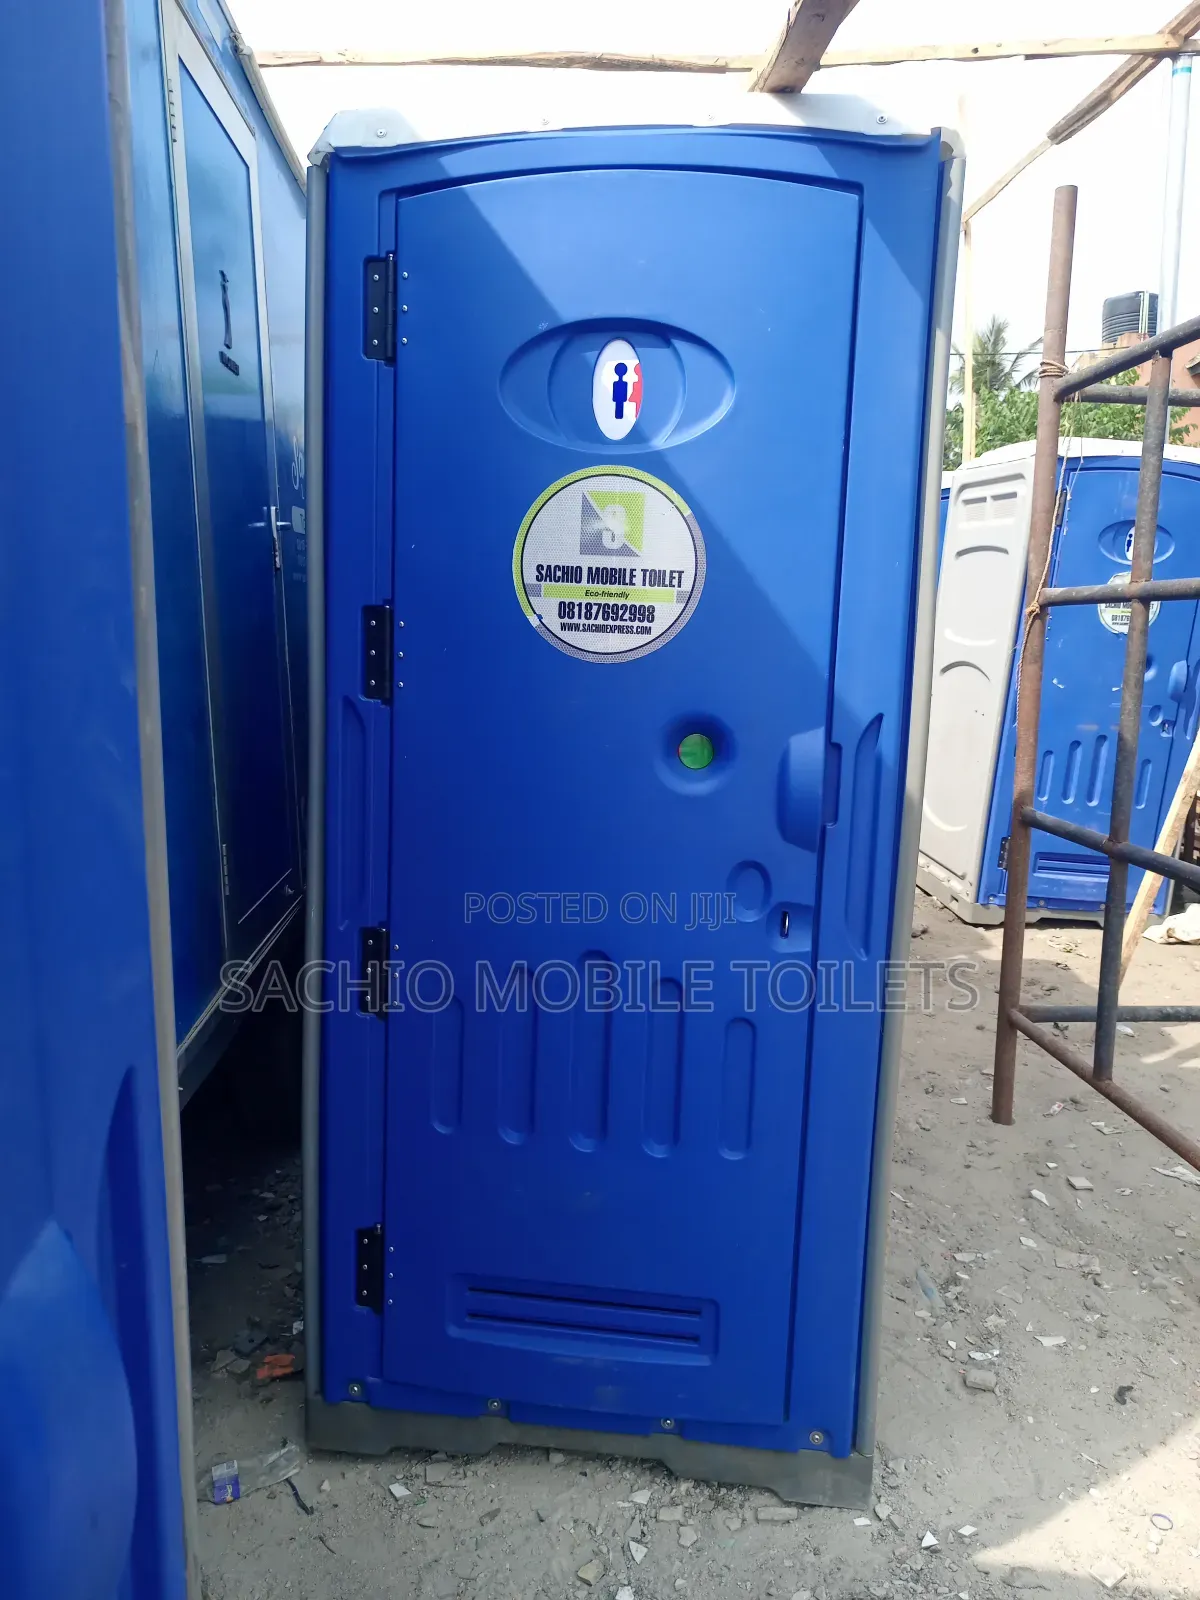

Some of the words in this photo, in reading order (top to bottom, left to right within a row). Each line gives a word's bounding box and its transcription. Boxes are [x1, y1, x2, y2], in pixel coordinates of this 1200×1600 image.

[535, 563, 583, 584] SACHIO
[586, 566, 637, 587] MOBILE
[640, 568, 685, 589] TOILET
[584, 589, 630, 600] Eco-friendly
[557, 600, 656, 624] 08187692998
[560, 621, 652, 636] WWW.SACHIOEXPRESS.COM
